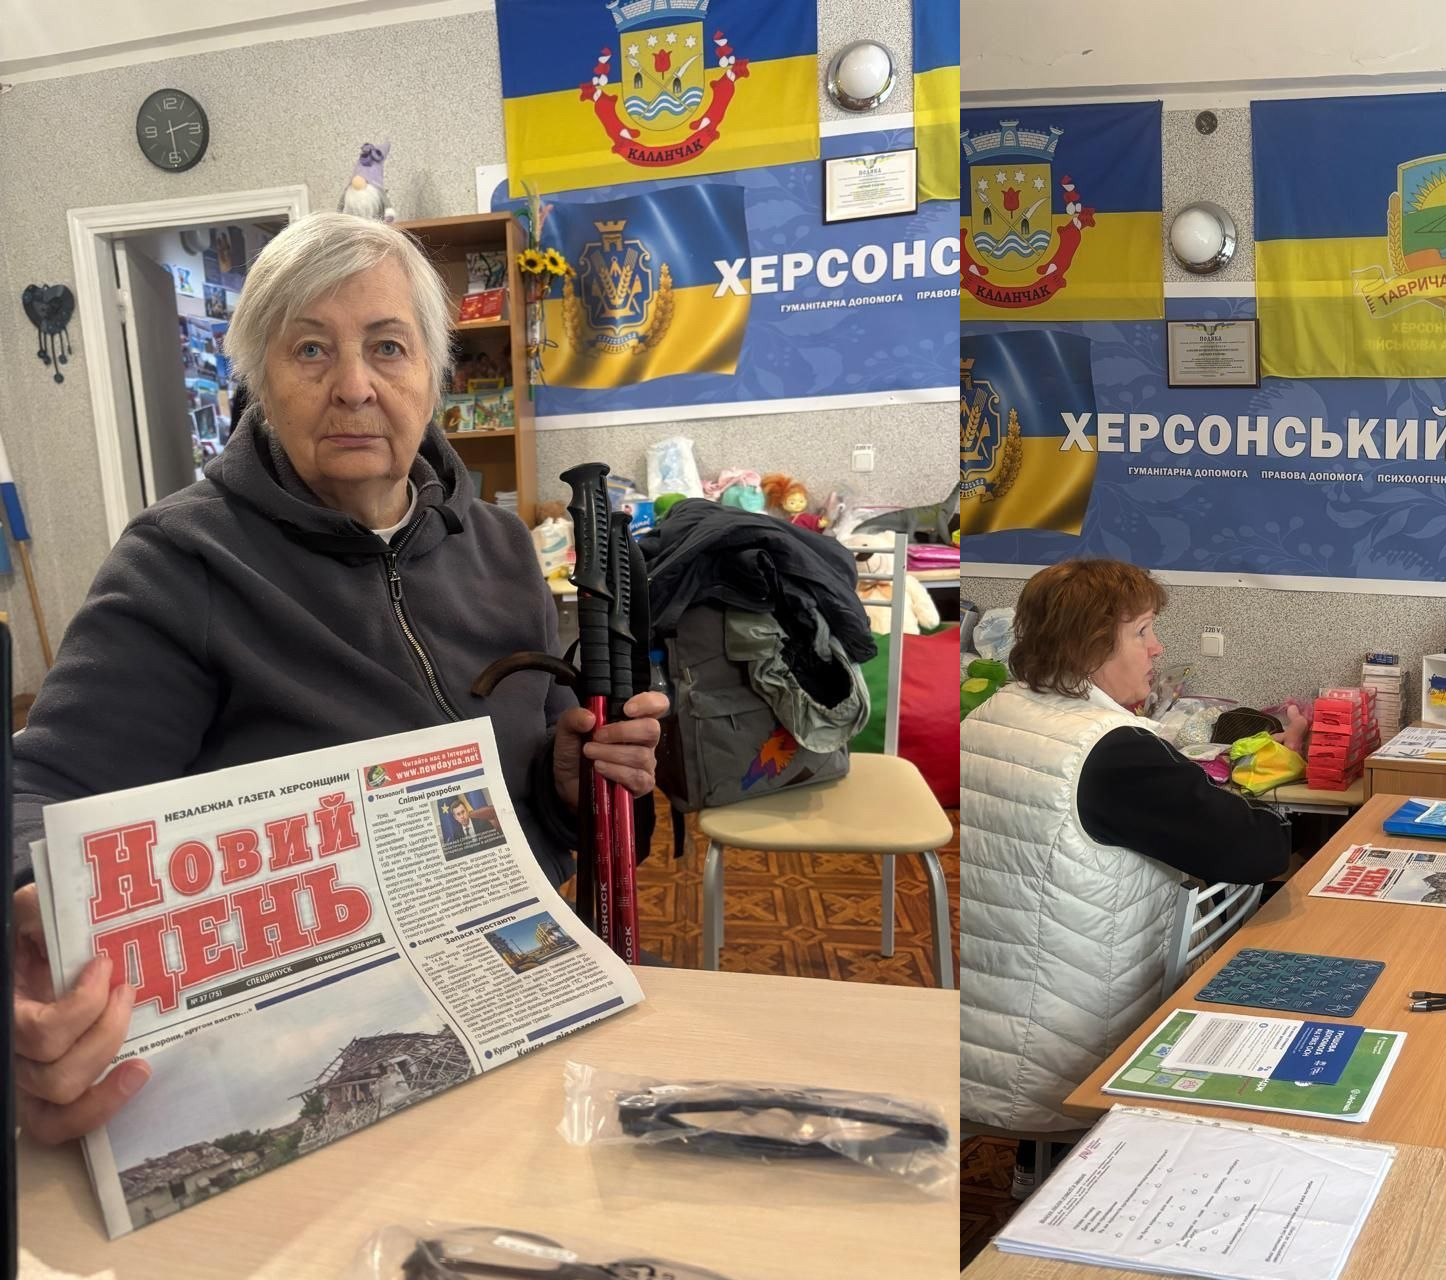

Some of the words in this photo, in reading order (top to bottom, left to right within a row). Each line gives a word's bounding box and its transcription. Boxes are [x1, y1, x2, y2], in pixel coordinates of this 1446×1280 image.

[618, 138, 704, 162] КАЛАНЧАК
[712, 236, 960, 298] ХЕРСОНС
[780, 299, 847, 312] ГУМАНІТАРНА
[848, 294, 904, 308] ДОПОМОГА
[975, 284, 1051, 303] КАЛАНЧАК
[1128, 466, 1192, 477] ГУМАНІТАРНА
[1194, 468, 1248, 478] ДОПОМОГА
[1261, 470, 1306, 480] ПРАВОВА
[1308, 472, 1363, 482] ДОПОМОГА
[396, 754, 479, 780] www.newdayua.net
[402, 758, 428, 768] Читайте
[164, 798, 234, 823] НЕЗАЛЕЖНА
[238, 789, 276, 805] ГАЗЕТА
[279, 772, 350, 796] ХЕРСОНЩИНИ
[375, 789, 405, 800] Технології
[398, 793, 425, 805] Спільні
[426, 785, 462, 800] розробки
[600, 881, 608, 945] ISHOCK
[417, 929, 454, 946] Енергетика
[444, 931, 474, 946] Запаси
[475, 915, 517, 934] зростають
[323, 949, 349, 962] вересня
[366, 937, 382, 948] року
[246, 966, 293, 987] СПЕЦВИПУСК
[493, 1037, 525, 1055] Культура
